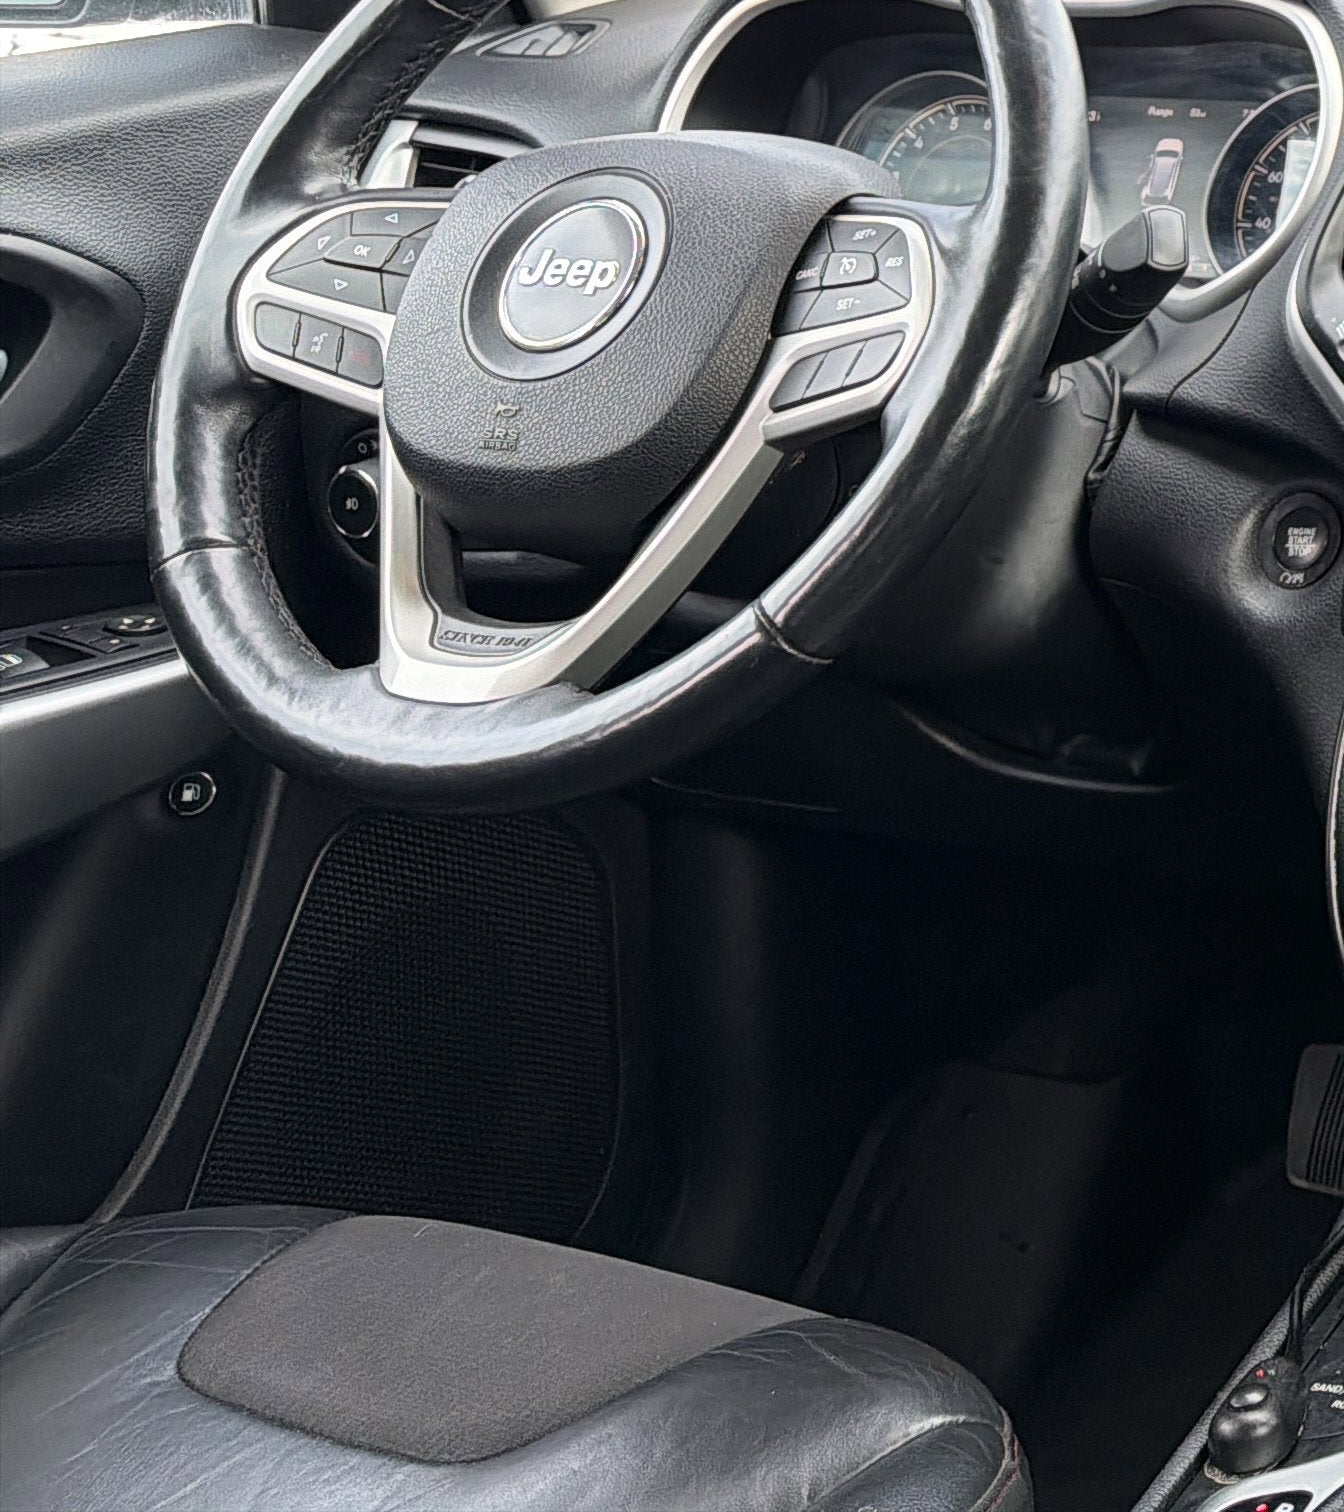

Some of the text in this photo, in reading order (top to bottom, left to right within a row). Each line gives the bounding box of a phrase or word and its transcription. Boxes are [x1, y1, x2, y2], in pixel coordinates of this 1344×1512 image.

[1267, 172, 1284, 183] 60
[1254, 217, 1272, 229] 40
[353, 244, 371, 258] OK
[518, 249, 620, 296] Jeep
[483, 427, 520, 440] SRS
[477, 440, 518, 452] AIRBAG
[1288, 527, 1317, 536] ENGINE
[1288, 536, 1314, 546] START
[1288, 546, 1312, 557] STOP
